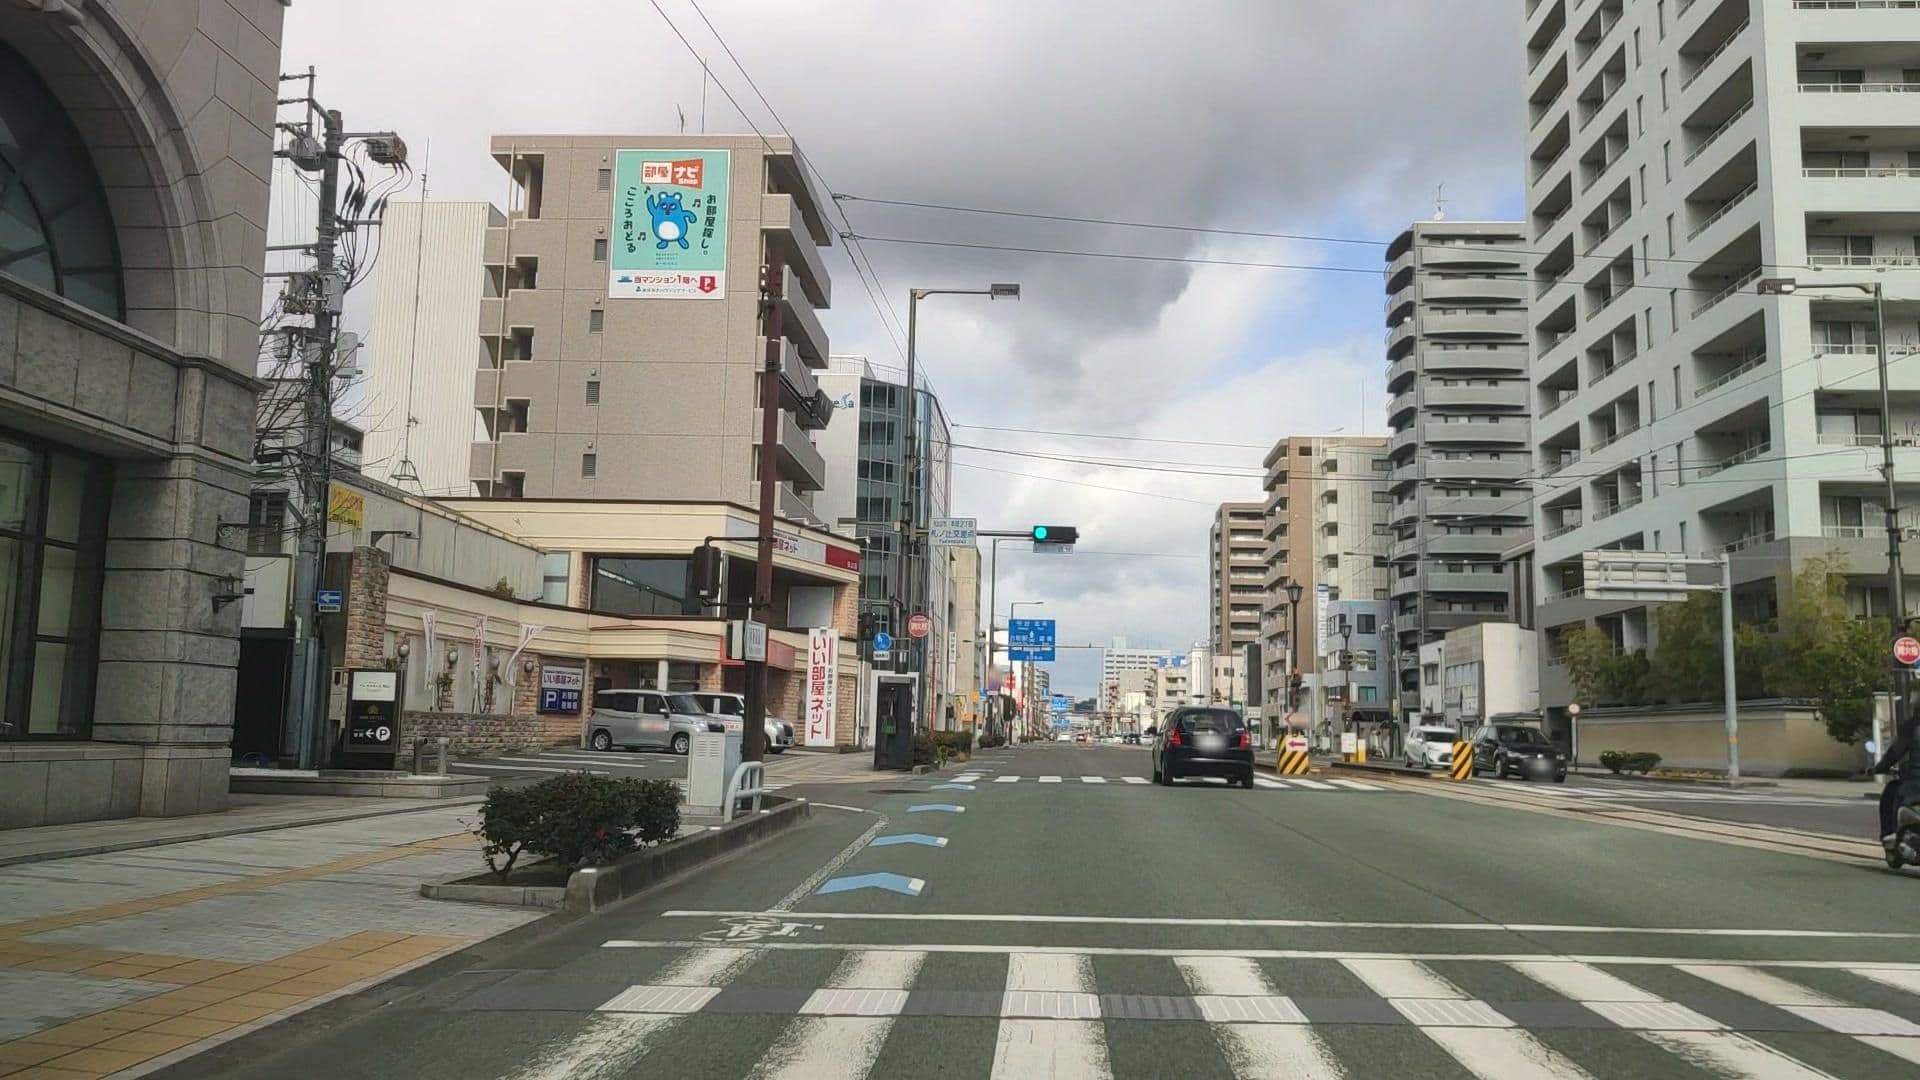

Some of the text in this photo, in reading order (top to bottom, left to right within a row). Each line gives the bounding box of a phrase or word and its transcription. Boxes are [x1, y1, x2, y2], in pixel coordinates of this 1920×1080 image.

[623, 186, 637, 253] こころおどる
[701, 194, 717, 256] お部屋探し。
[545, 691, 557, 708] P
[811, 636, 826, 739] いい部屋ネット
[379, 728, 388, 739] P
